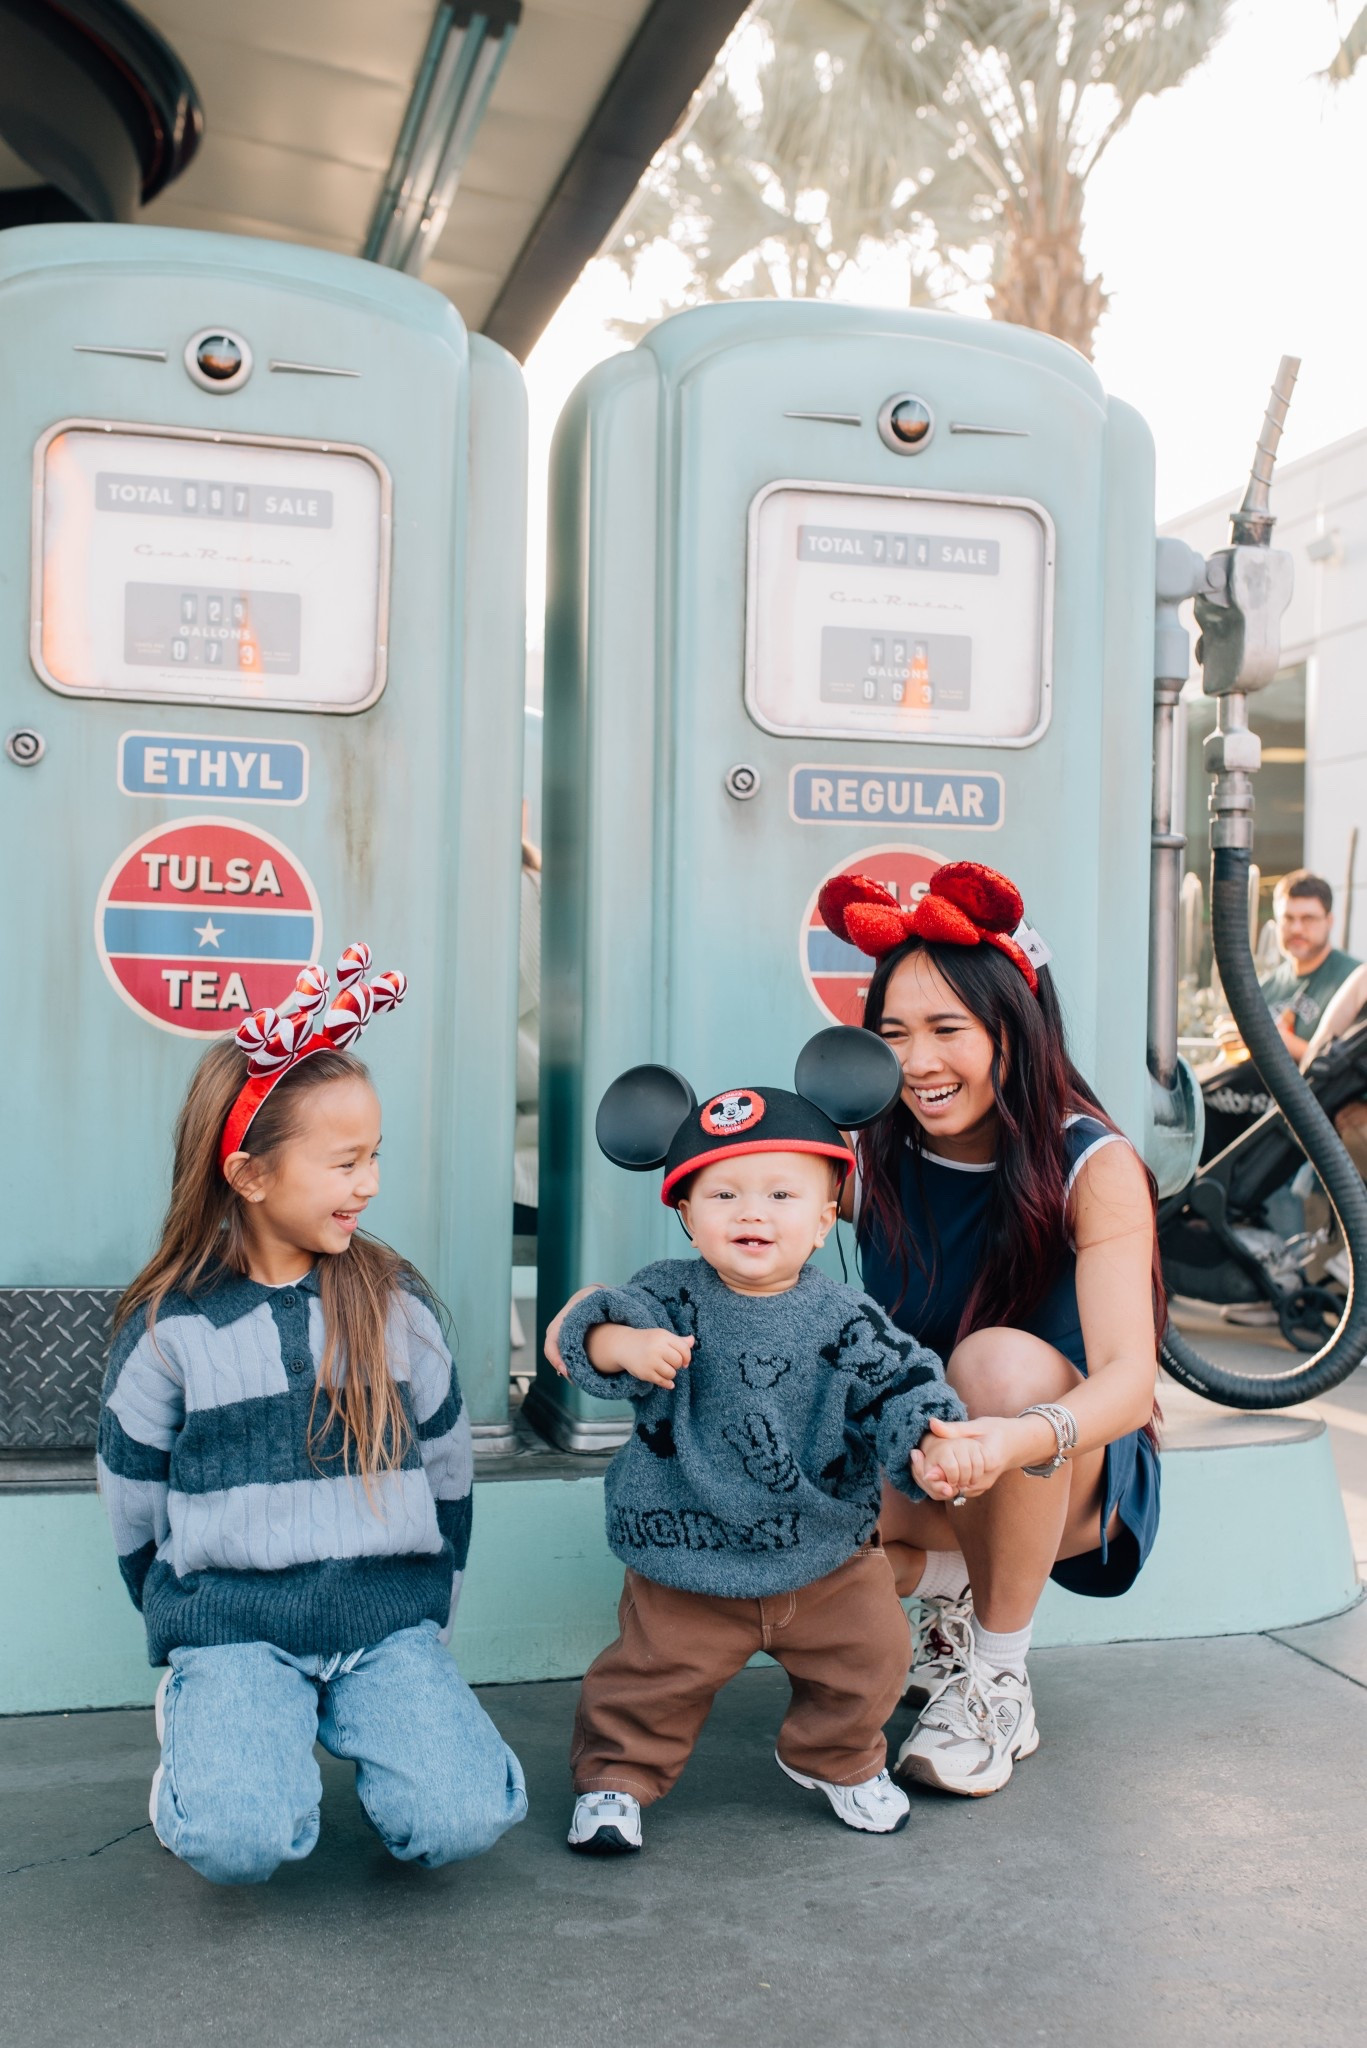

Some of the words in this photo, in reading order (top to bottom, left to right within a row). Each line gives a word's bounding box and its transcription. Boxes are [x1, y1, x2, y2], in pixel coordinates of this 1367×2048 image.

[109, 483, 174, 505] TOTAL
[265, 496, 319, 517] SALE
[808, 536, 864, 556] TOTAL
[941, 546, 988, 566] SALE
[179, 625, 251, 641] GALLONS
[867, 666, 929, 680] GALLONS
[144, 747, 283, 790] ETHYL
[810, 778, 985, 818] REGULAR
[141, 853, 284, 897] TULSA
[161, 969, 252, 1011] TEA
